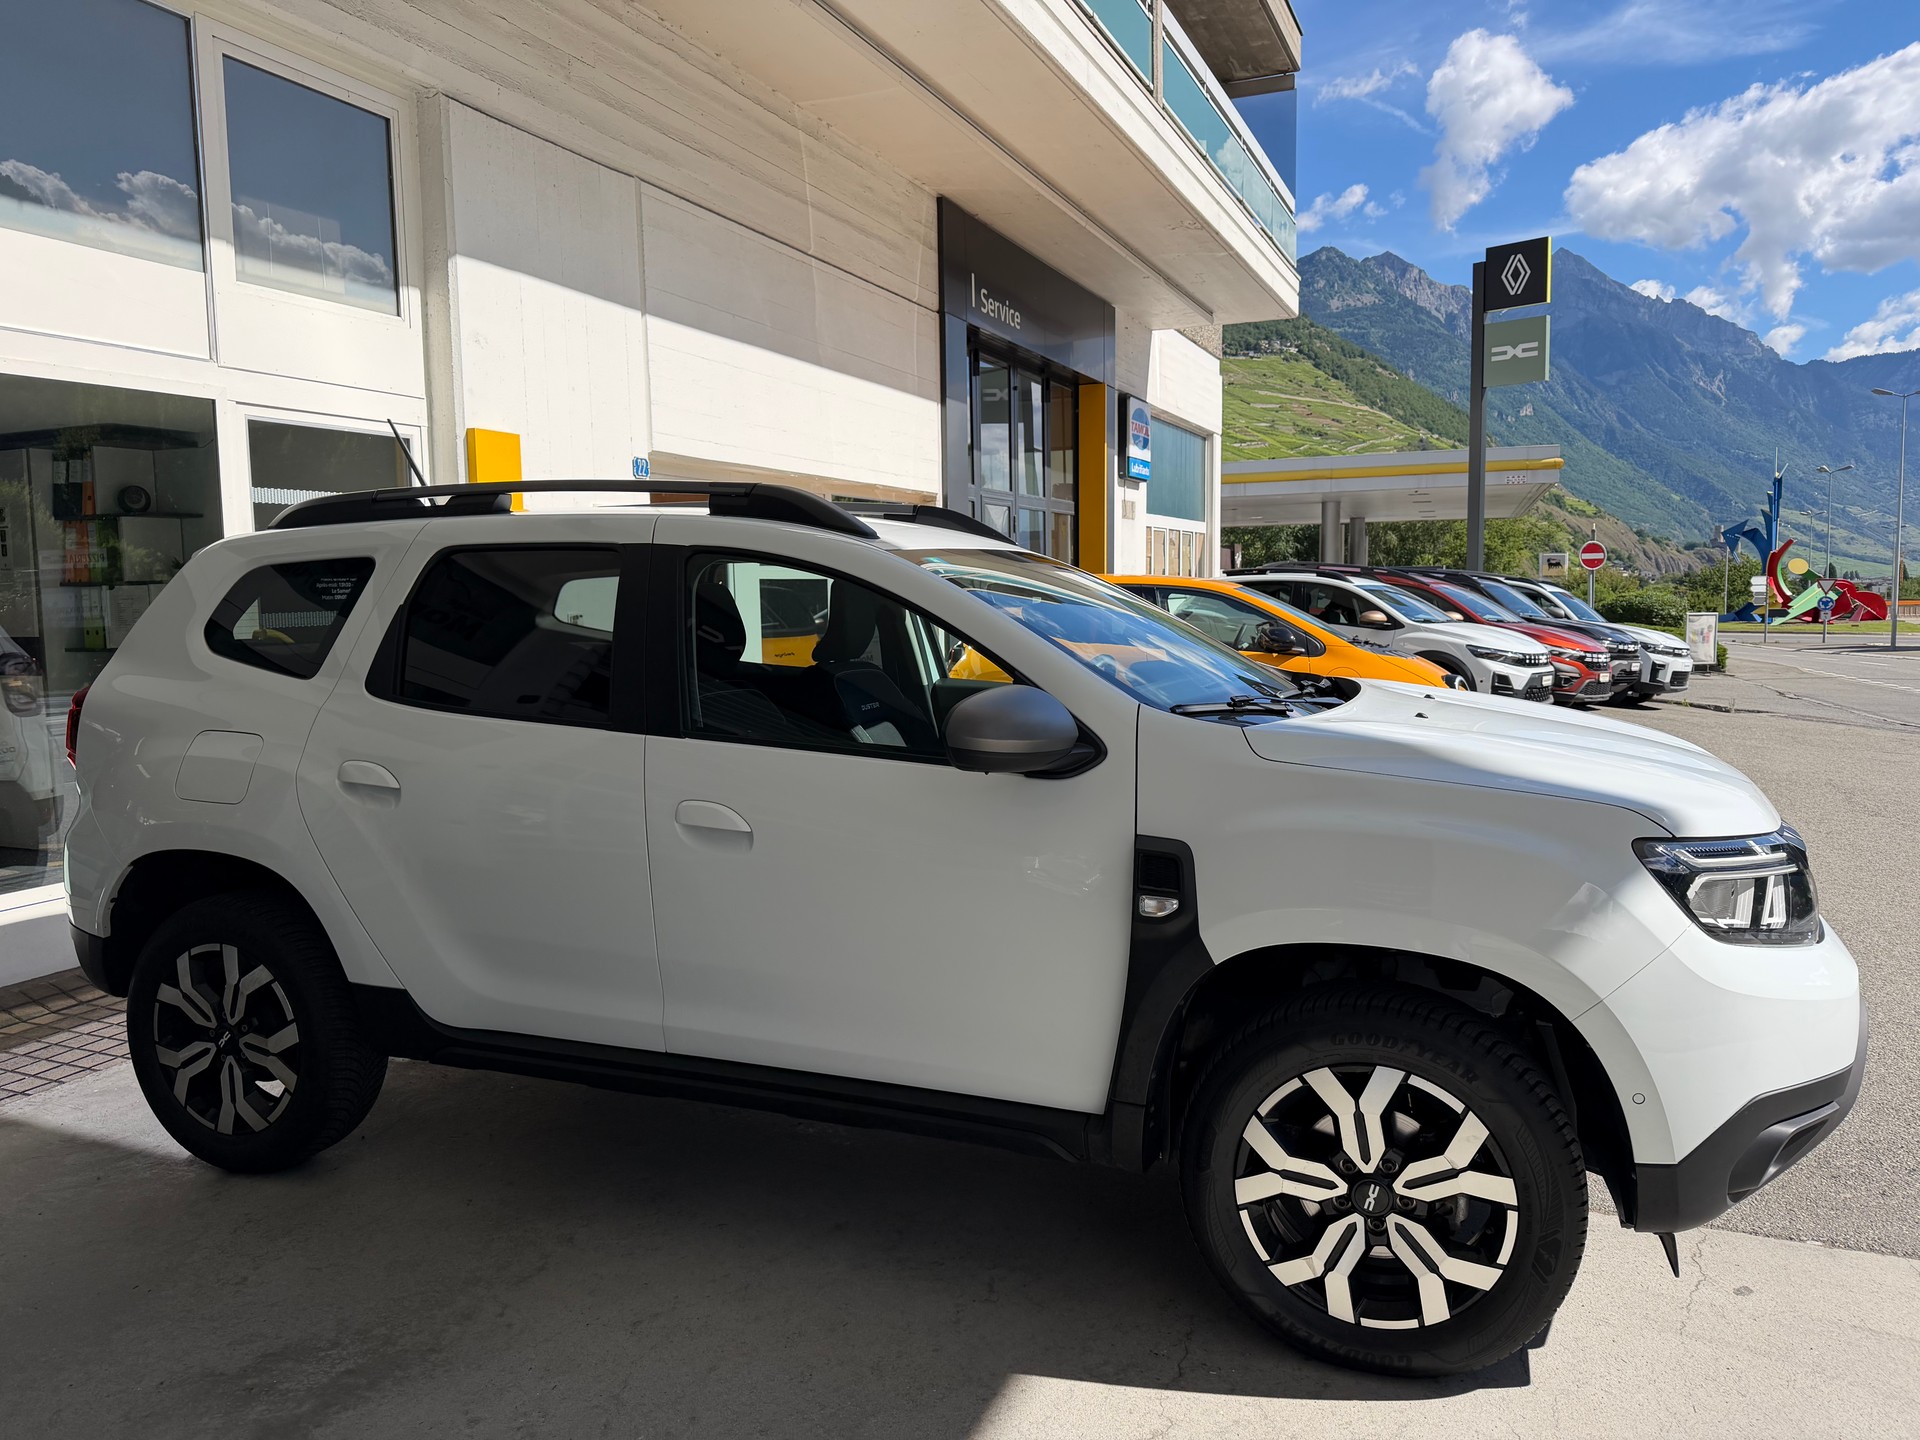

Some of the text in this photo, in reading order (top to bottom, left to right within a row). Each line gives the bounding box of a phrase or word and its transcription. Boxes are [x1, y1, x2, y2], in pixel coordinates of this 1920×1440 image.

[980, 288, 1021, 330] Service
[1131, 422, 1149, 437] TAMOIL
[637, 459, 647, 476] 22
[1330, 1031, 1480, 1085] GOODYEAR
